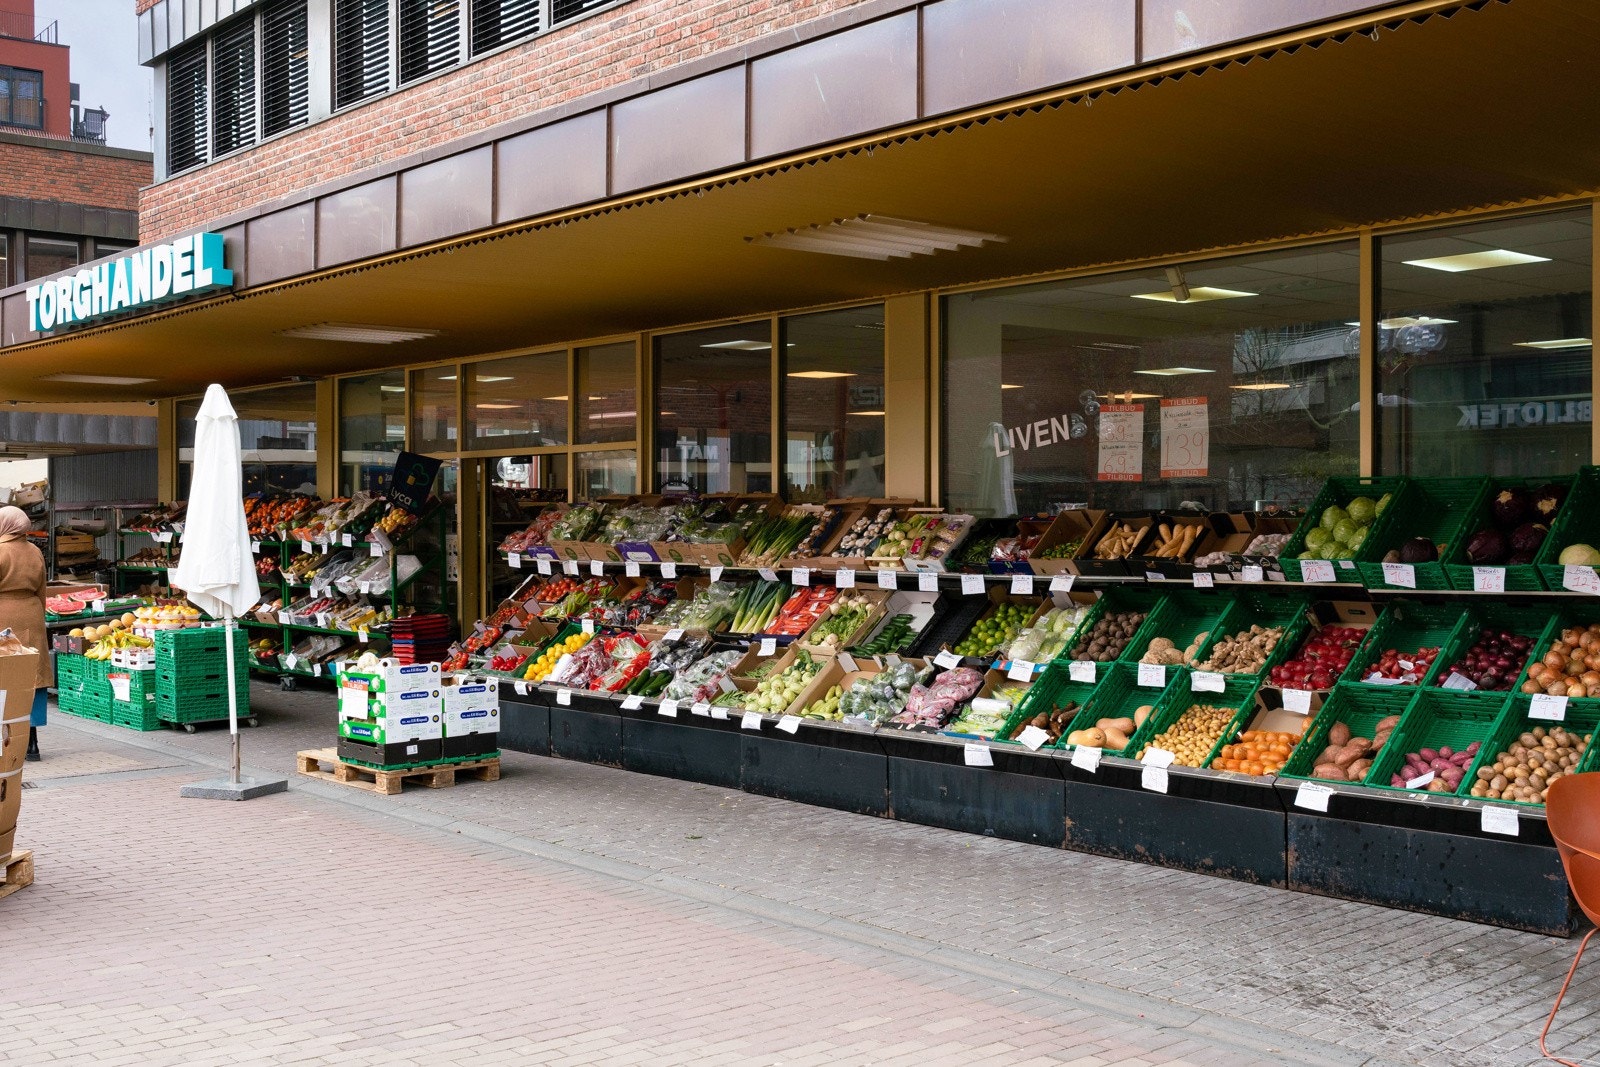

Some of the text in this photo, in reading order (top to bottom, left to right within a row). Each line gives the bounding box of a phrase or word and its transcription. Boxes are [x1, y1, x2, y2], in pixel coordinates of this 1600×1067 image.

[26, 232, 213, 332] TORGHANDEL
[1169, 398, 1198, 406] TILBUD
[994, 414, 1070, 458] LIVEN
[1163, 431, 1204, 468] 139
[1107, 473, 1134, 481] TILBUD
[1170, 469, 1198, 477] TILBUD
[390, 486, 413, 506] Lyca
